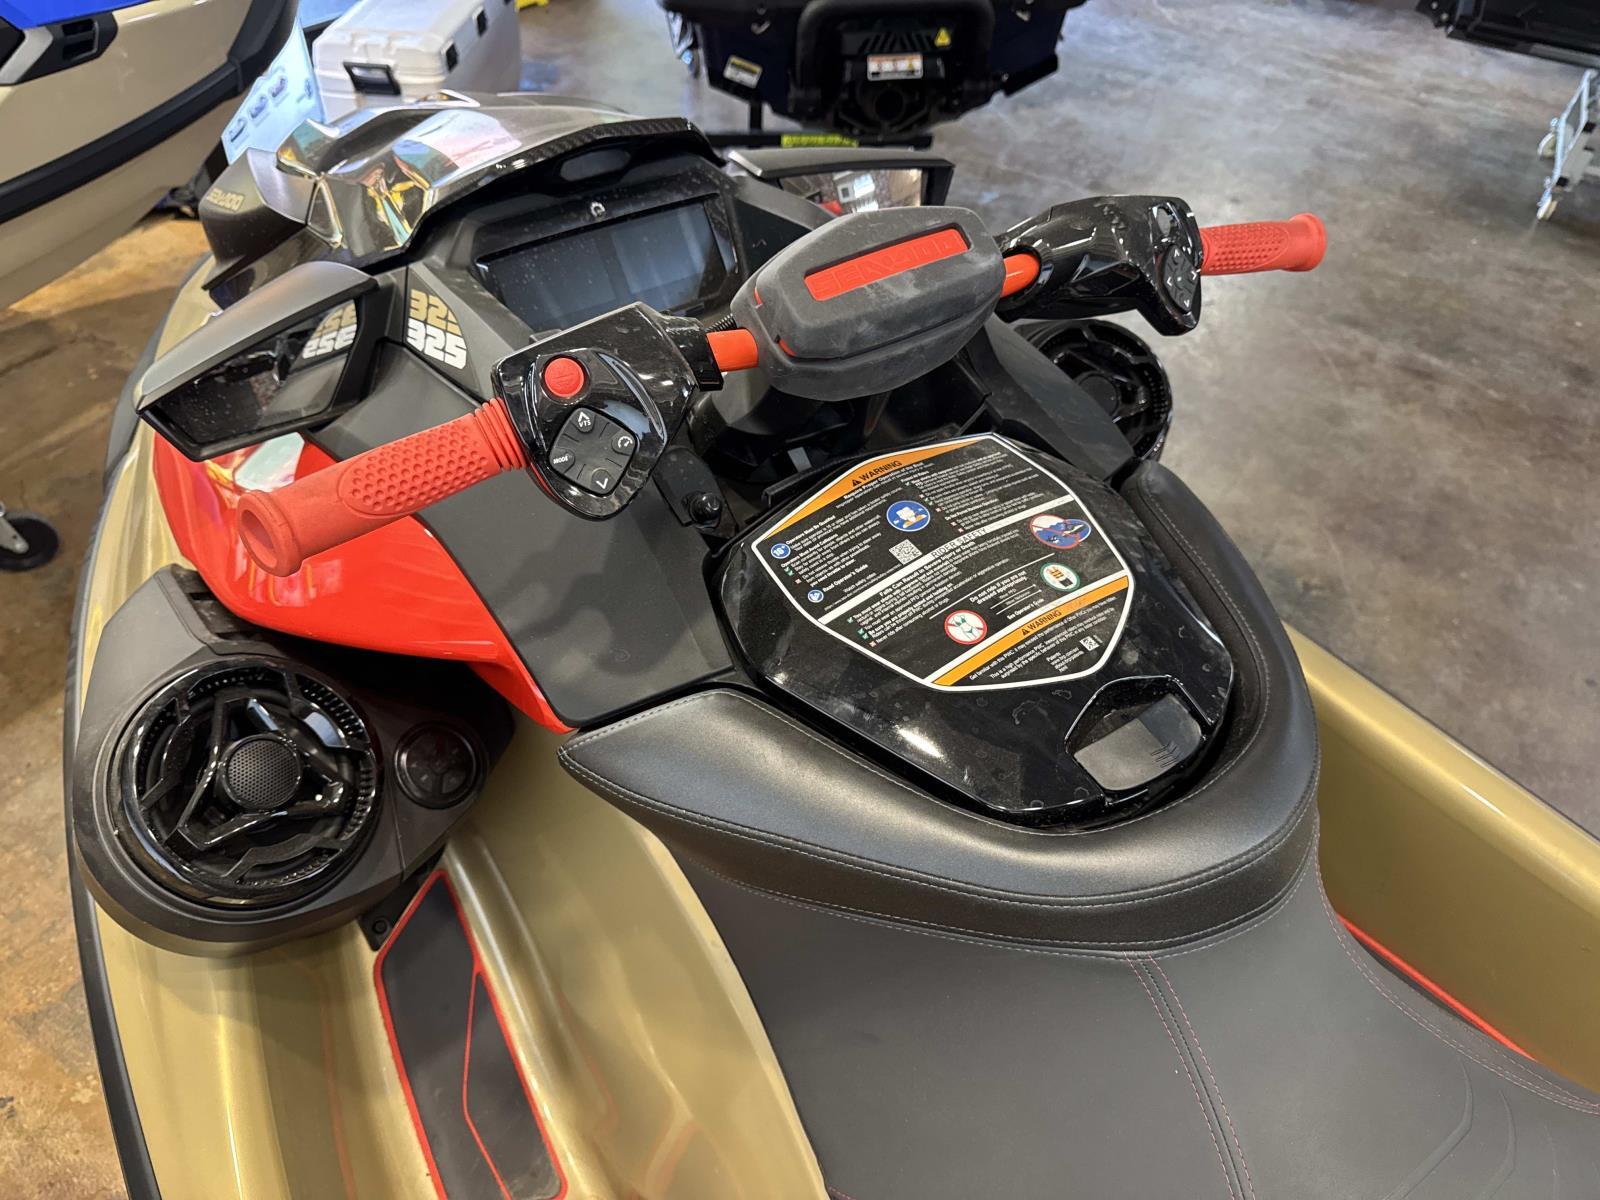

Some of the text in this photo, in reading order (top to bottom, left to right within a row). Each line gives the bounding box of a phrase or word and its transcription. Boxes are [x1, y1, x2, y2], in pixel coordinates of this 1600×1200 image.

[407, 317, 467, 370] 325
[579, 419, 592, 428] VTS
[553, 455, 569, 464] MODE
[859, 460, 903, 481] WARNING
[929, 527, 988, 558] RIDER SAFETY
[822, 583, 835, 592] Read
[854, 563, 869, 574] Guide
[878, 586, 893, 597] Falls
[890, 580, 904, 590] Can
[901, 571, 920, 583] Result
[923, 558, 943, 571] Severe
[940, 550, 957, 561] Injury
[960, 540, 976, 551] Death
[968, 594, 979, 602] Do
[976, 590, 988, 598] not
[984, 584, 998, 593] ride
[999, 577, 1012, 586] you
[1026, 610, 1063, 631] WARNING
